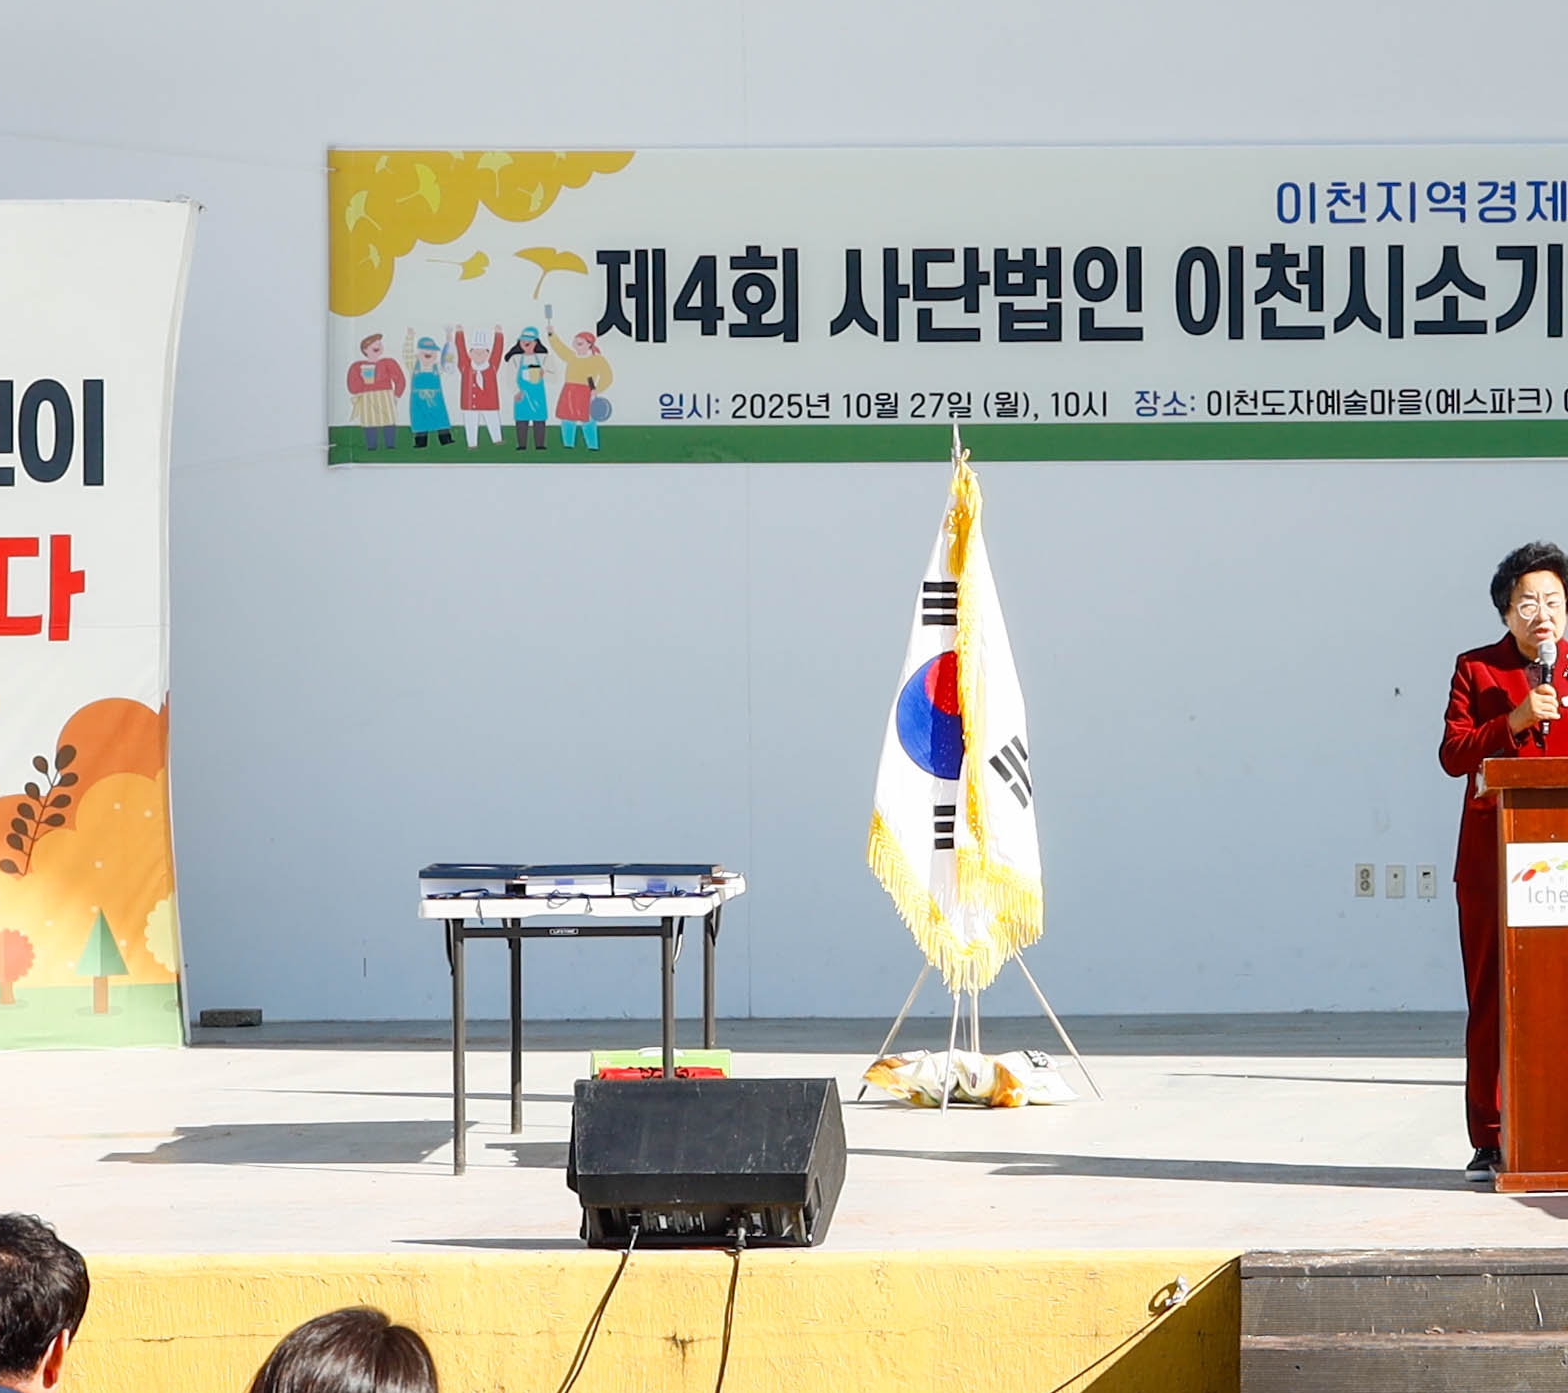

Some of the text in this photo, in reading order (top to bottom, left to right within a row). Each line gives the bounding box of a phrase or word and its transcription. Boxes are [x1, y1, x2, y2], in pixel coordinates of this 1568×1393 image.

[595, 247, 799, 344] 제4회
[830, 245, 1143, 343] 사단법인
[659, 393, 720, 420] 일시:
[731, 393, 830, 419] 2025년
[843, 392, 899, 418] 10월
[910, 392, 972, 418] 27일
[1050, 391, 1108, 418] 10시
[1134, 390, 1195, 418] 장소:
[1207, 387, 1553, 417] 이천도자예술마을(예스파크)
